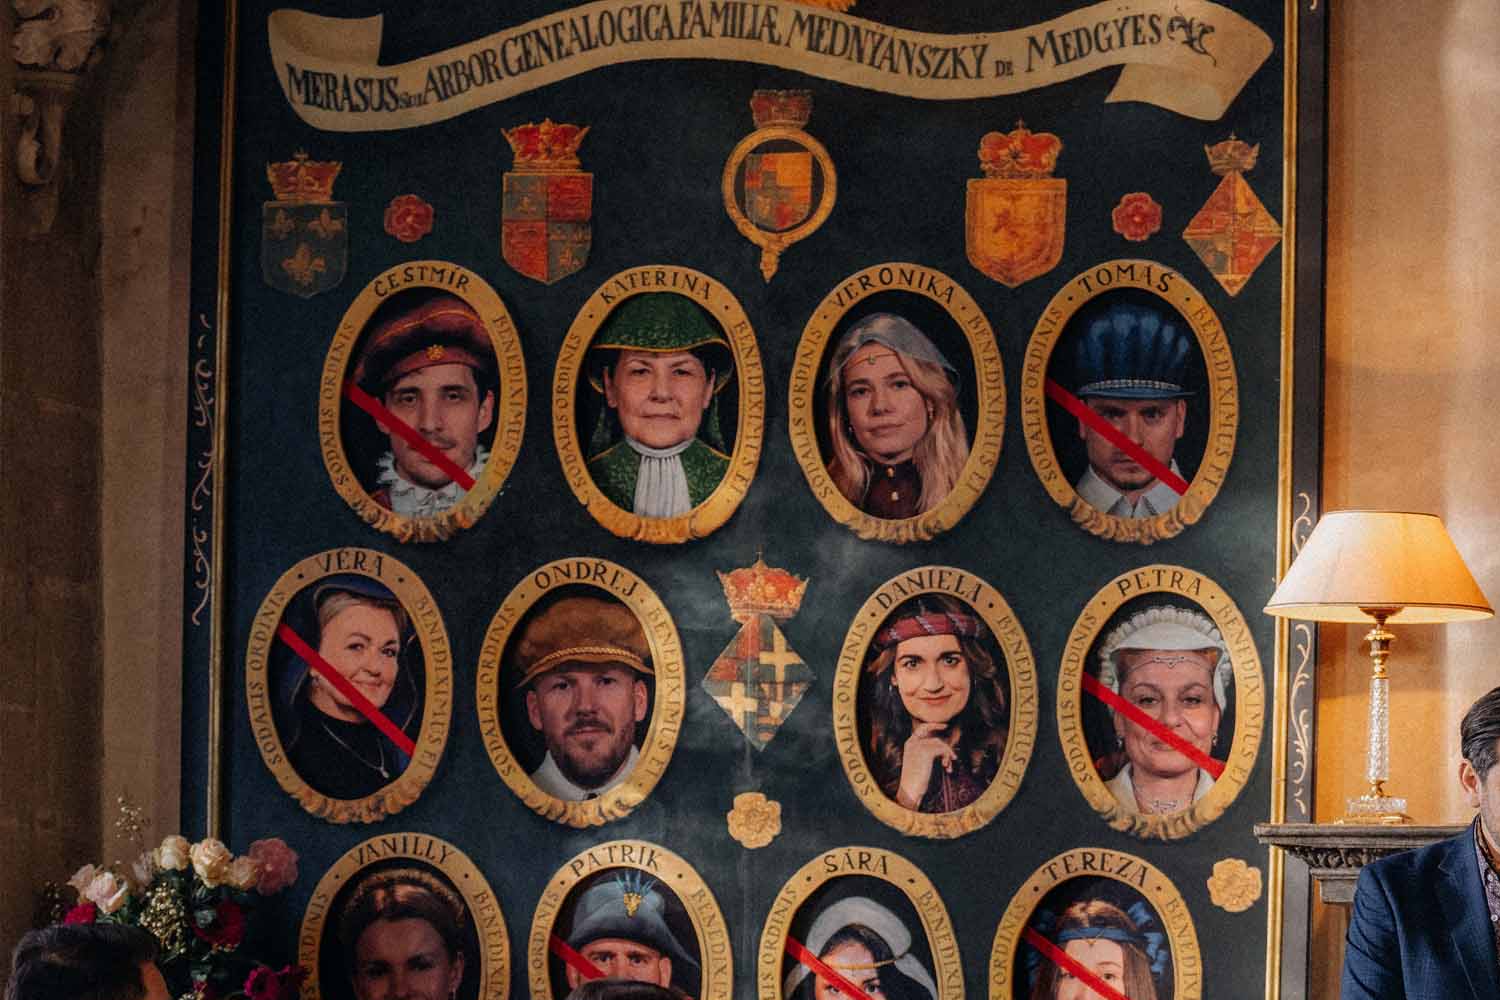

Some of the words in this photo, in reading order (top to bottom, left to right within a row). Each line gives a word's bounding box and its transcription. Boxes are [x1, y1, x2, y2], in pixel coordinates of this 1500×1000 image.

[287, 64, 399, 112] MERASUS
[422, 48, 503, 104] ARBOR
[501, 4, 676, 76] GENEALOGICA
[829, 266, 954, 308] VERONIKA
[793, 416, 833, 500] SODALIS
[1025, 397, 1058, 483] SODALIS
[876, 568, 982, 609] DANIELA
[1117, 568, 1202, 597] PETRA
[837, 618, 868, 703] ORDINIS
[1061, 612, 1097, 691] ORDINIS
[480, 694, 515, 777] SODALIS
[837, 713, 874, 797] SODALIS
[1061, 699, 1092, 785] SODALIS
[351, 835, 456, 866] VANILLY
[570, 844, 663, 877] PATRIK
[1042, 851, 1148, 887] TEREZA
[763, 886, 798, 964] ORDINIS
